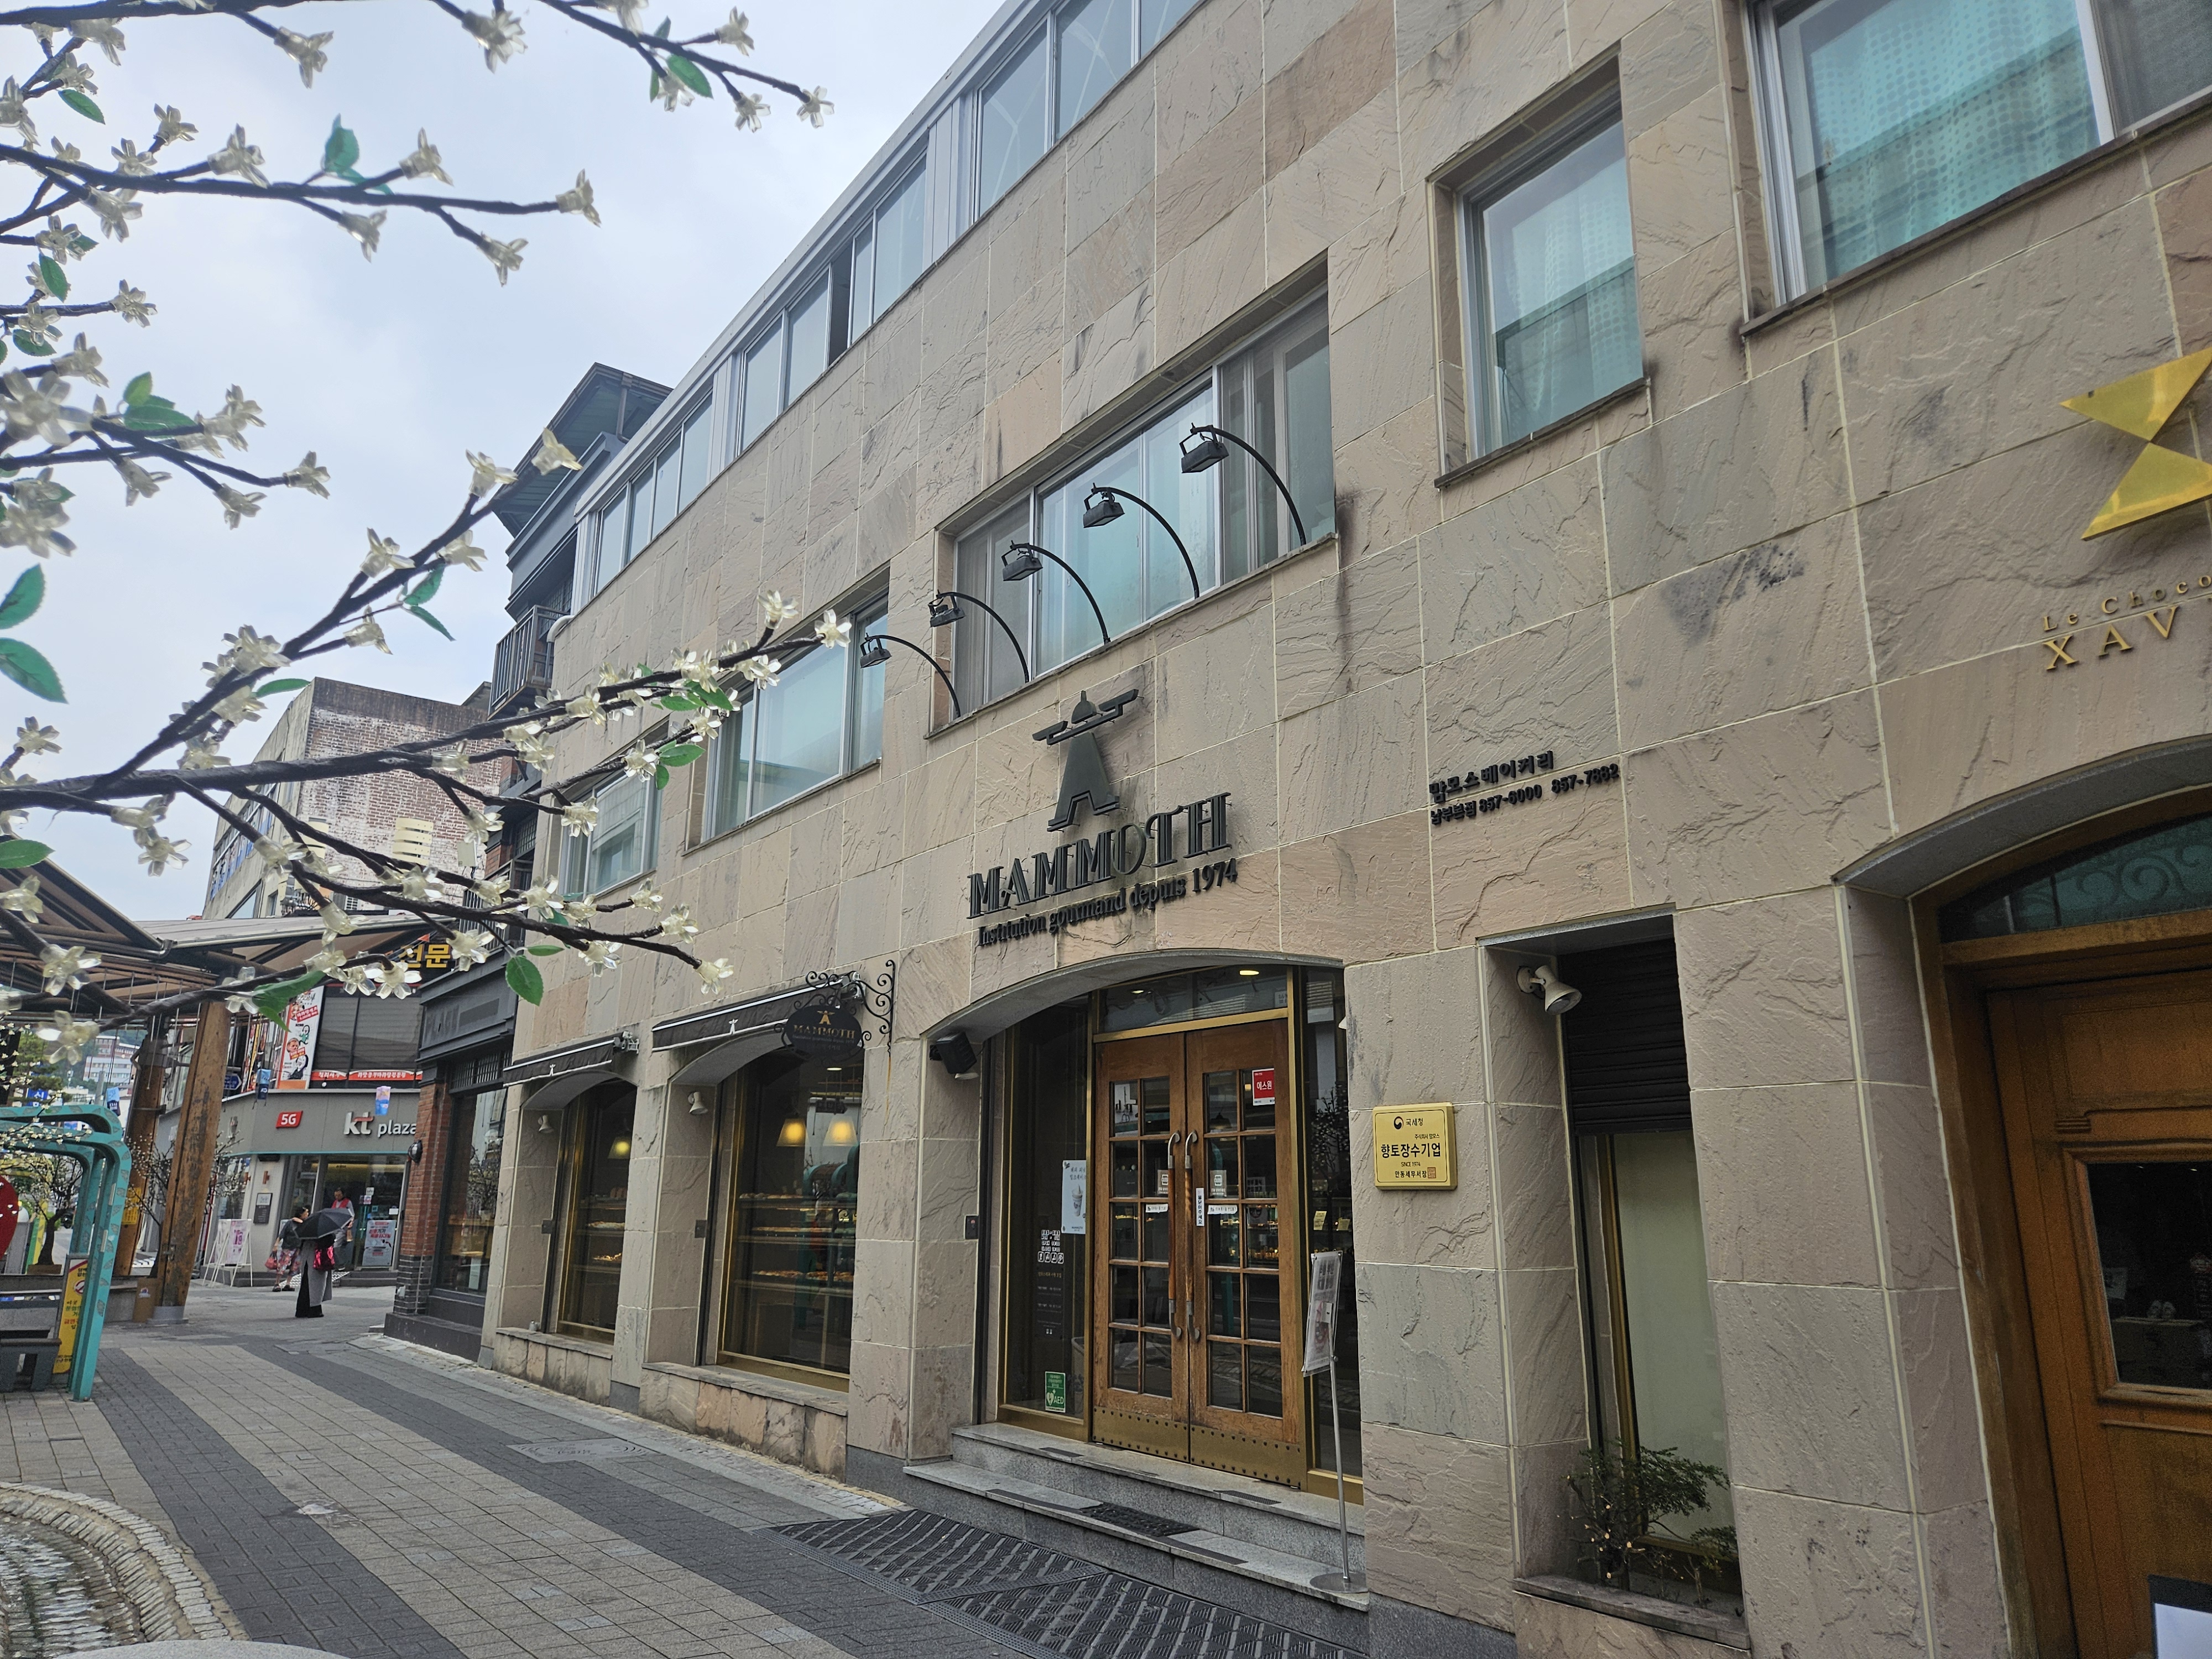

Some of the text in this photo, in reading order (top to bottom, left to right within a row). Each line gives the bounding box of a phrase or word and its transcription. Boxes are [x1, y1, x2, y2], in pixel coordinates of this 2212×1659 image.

[2043, 575, 2212, 632] Le Choco
[2042, 596, 2212, 671] XAV
[1429, 750, 1554, 804] 맘모스베이커리
[1479, 784, 1543, 812] 857-6000
[1551, 763, 1620, 794] 857-7882
[967, 792, 1233, 919] MAMMOTH
[978, 858, 1238, 947] Institution gourmand depuis 1974
[794, 1024, 855, 1039] MAMMOTH
[1256, 1081, 1272, 1091] 에스원
[280, 1113, 297, 1125] 5G
[343, 1111, 417, 1138] kt plaza
[1406, 1118, 1423, 1126] 국세청
[1381, 1142, 1441, 1159] 향토장수기업
[1395, 1170, 1427, 1178] 안동세무서장
[1053, 1396, 1064, 1404] AED
